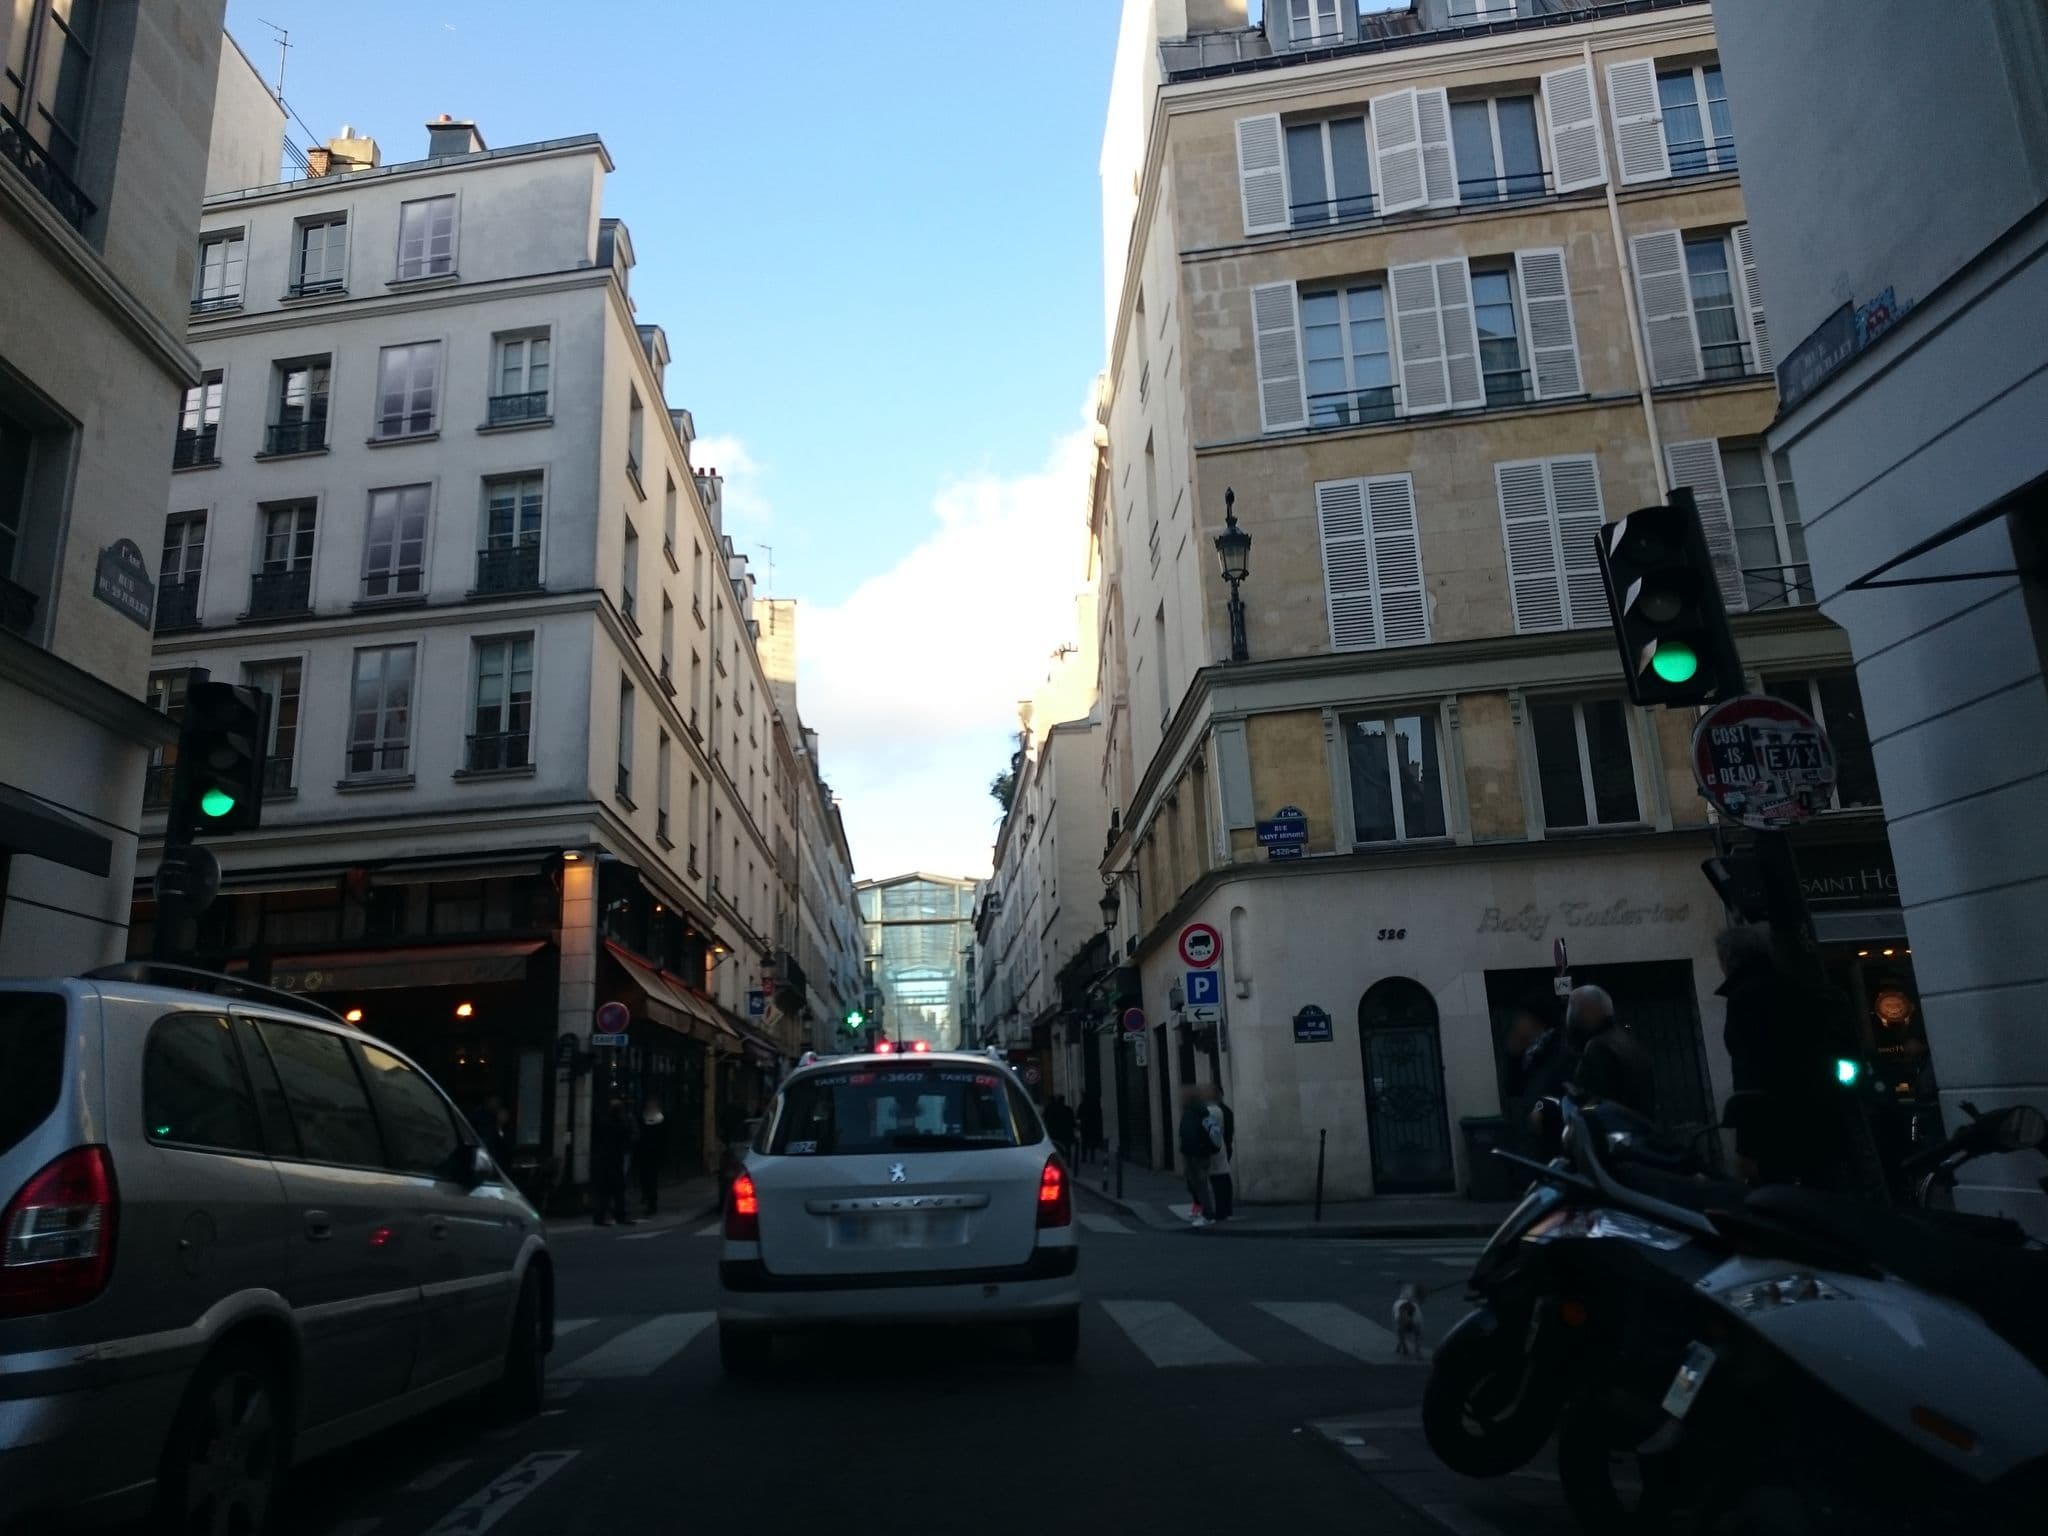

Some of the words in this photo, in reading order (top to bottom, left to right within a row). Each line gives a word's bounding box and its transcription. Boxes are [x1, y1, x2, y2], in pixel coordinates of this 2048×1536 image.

[1711, 726, 1746, 745] COST
[1727, 747, 1742, 764] IS
[1719, 764, 1757, 785] DEAD
[1259, 832, 1278, 841] SAINT
[1476, 906, 1551, 943] Baby
[1377, 928, 1406, 941] 326
[1194, 976, 1210, 1000] P
[815, 1077, 848, 1087] TAXIS
[940, 1073, 972, 1082] TAXIS
